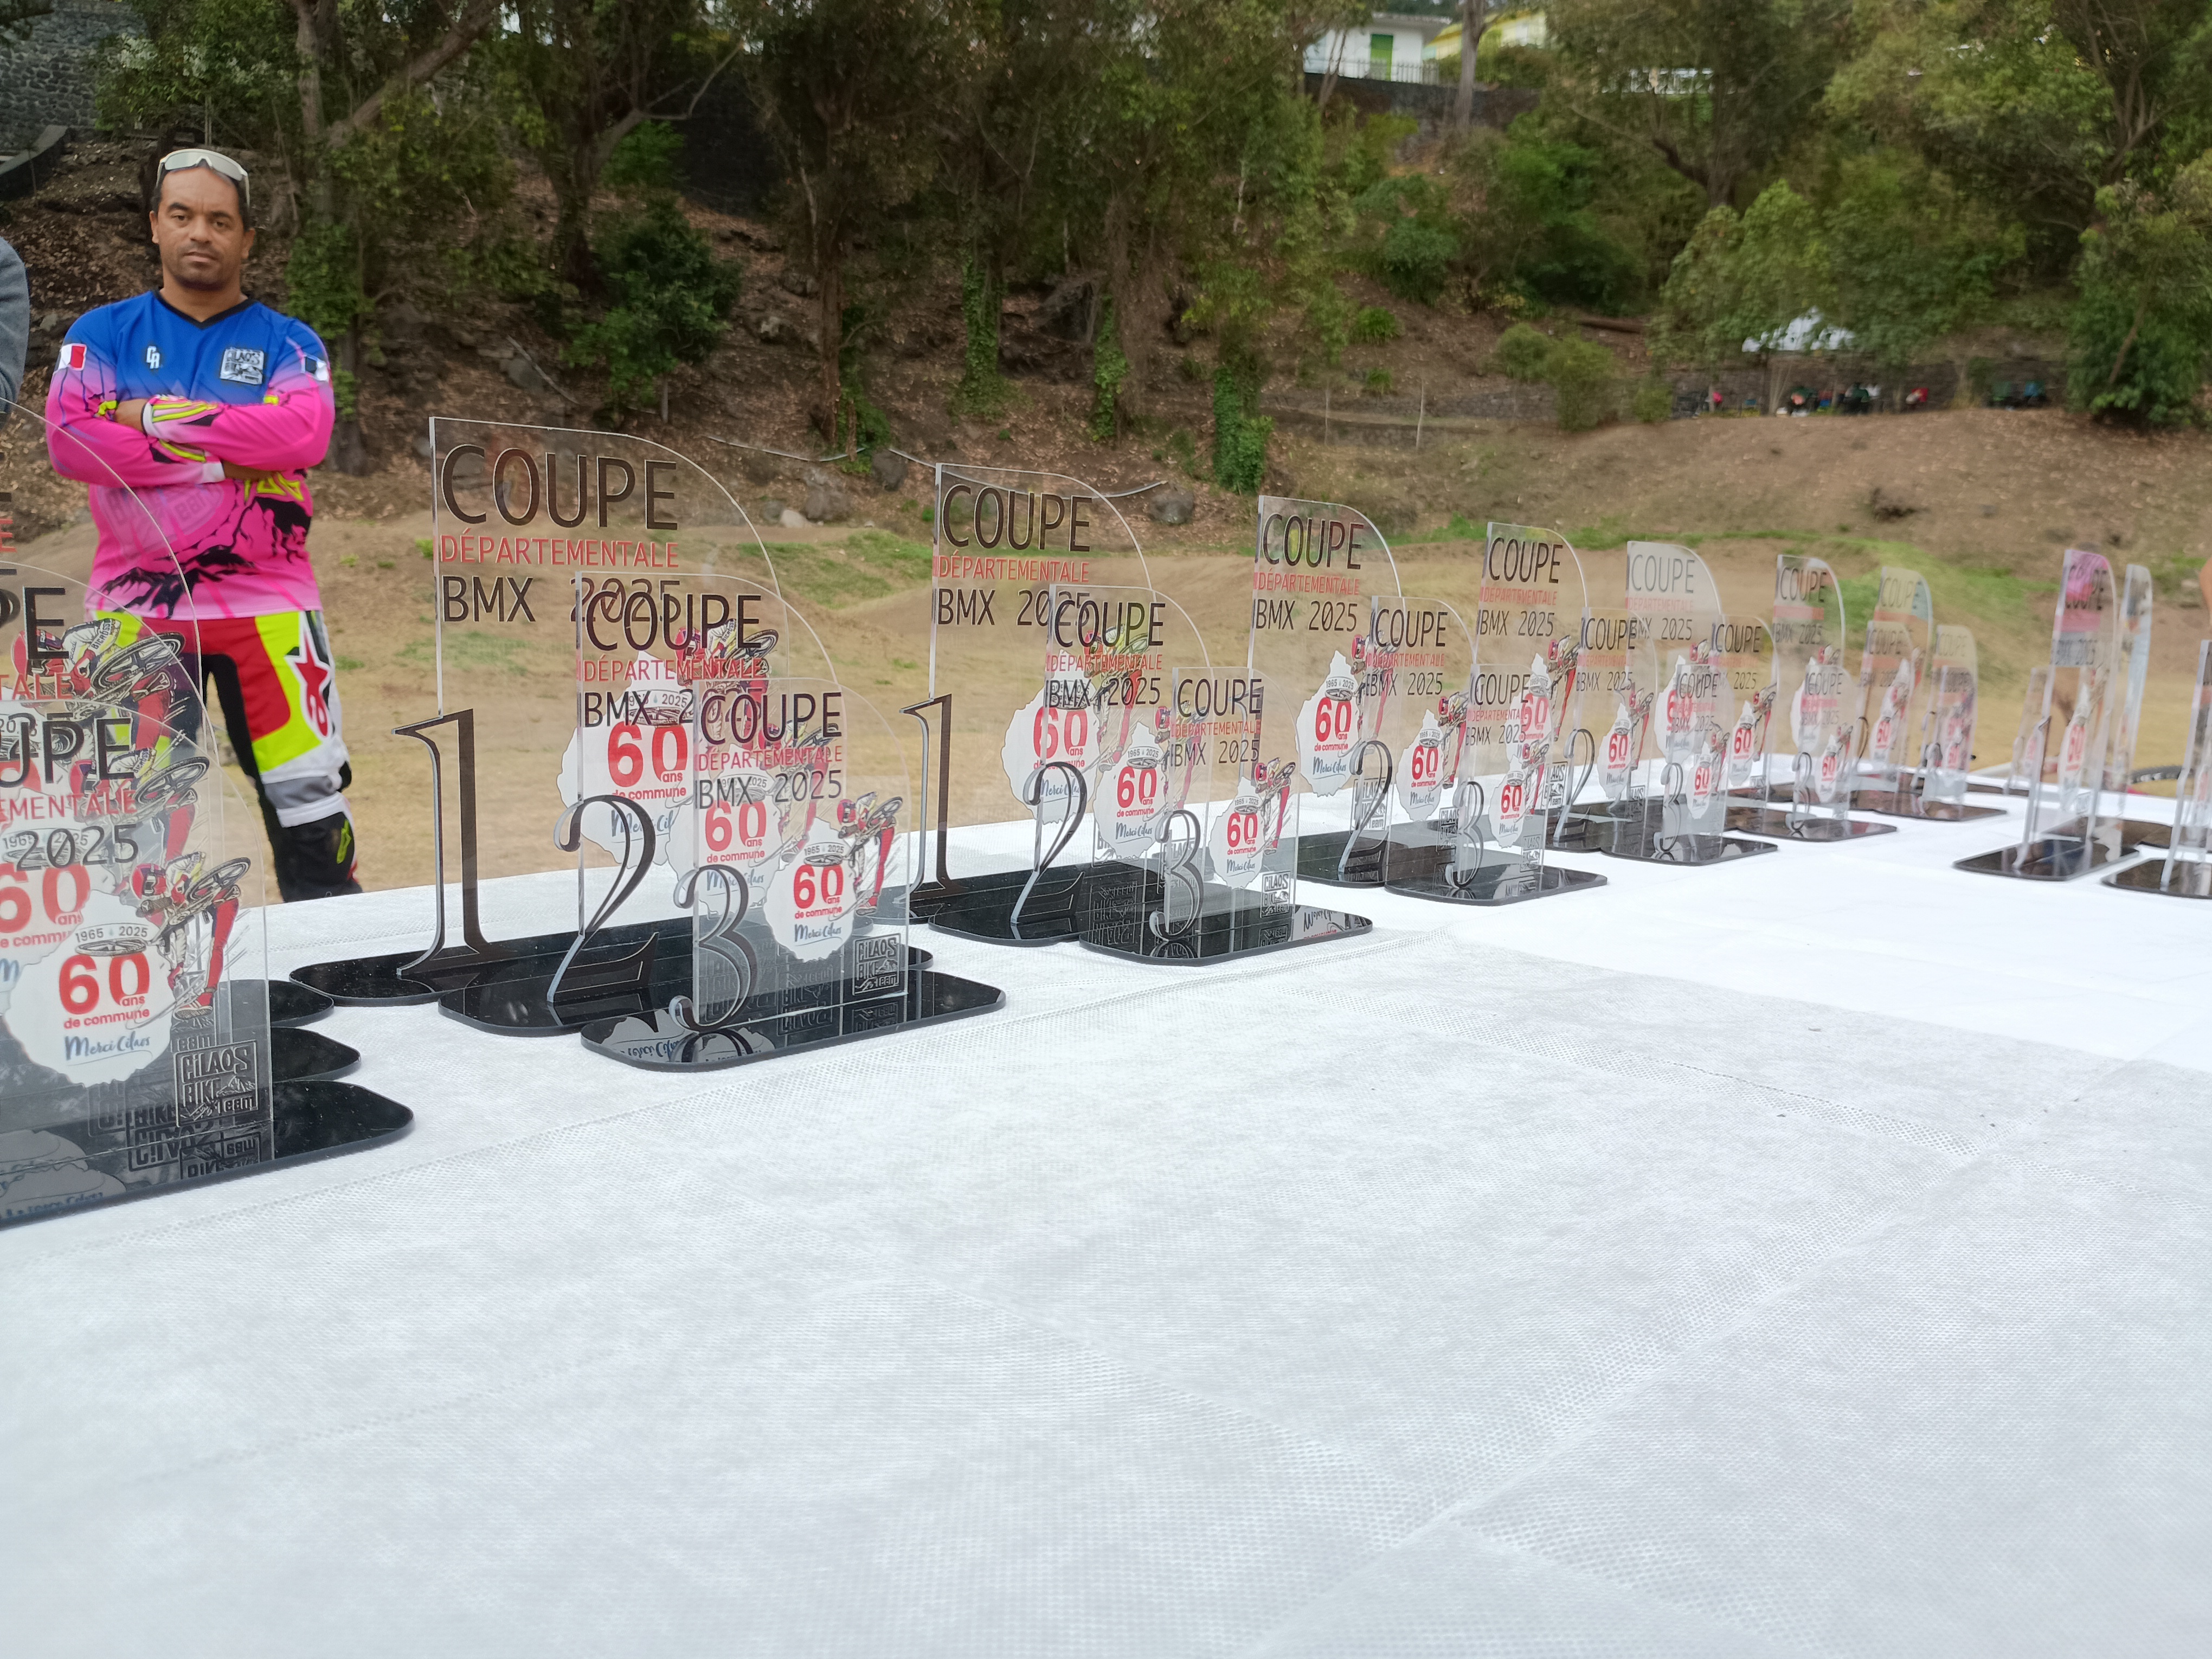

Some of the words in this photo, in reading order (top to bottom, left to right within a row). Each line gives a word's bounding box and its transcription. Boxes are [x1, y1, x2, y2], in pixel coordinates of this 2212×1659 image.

[441, 444, 678, 531] COUPE
[942, 484, 1092, 552] COUPE
[440, 528, 679, 568] DÉPARTEMENTALE
[1263, 513, 1364, 570] COUPE
[938, 549, 1090, 583] DÉPARTEMENTALE
[1489, 537, 1562, 584] COUPE
[1631, 554, 1695, 594] COUPE
[442, 575, 536, 622] BMX
[1258, 568, 1360, 595] DÉPARTEMENTALE
[1780, 567, 1827, 603] COUPE
[586, 590, 761, 651] COUPE
[938, 589, 995, 626] BMX
[1054, 600, 1165, 647] COUPE
[1256, 598, 1295, 630] BMX
[1309, 601, 1358, 632] 2025
[1480, 609, 1509, 636] BMX
[1518, 610, 1554, 636] 2025
[1375, 608, 1448, 648] COUPE
[1585, 618, 1637, 650] COUPE
[1661, 618, 1692, 640] 2025
[1715, 623, 1761, 653] COUPE
[583, 654, 763, 682] DÉPARTEMENTALE
[1326, 679, 1338, 687] 1965
[1342, 679, 1354, 690] 2025
[1407, 672, 1443, 696] 2025
[1606, 671, 1632, 691] 2025
[1733, 672, 1757, 690] 2025
[1050, 679, 1091, 708] BMX
[1107, 677, 1161, 706] 2025
[1178, 678, 1262, 717] COUPE
[1474, 674, 1531, 705] COUPE
[584, 690, 651, 728] BMX
[701, 692, 841, 745] COUPE
[1315, 697, 1352, 742] 60
[1033, 706, 1088, 759] 60
[1322, 742, 1348, 751] commune
[1499, 724, 1527, 744] 2025
[1609, 733, 1628, 763] 60
[1734, 728, 1752, 754] 60
[608, 720, 689, 788] 60
[698, 745, 843, 771] DÉPARTEMENTALE
[1069, 748, 1083, 756] ans
[1175, 742, 1206, 767] BMX
[1218, 739, 1259, 764] 2025
[1412, 745, 1438, 780] 60
[628, 787, 687, 801] commune
[663, 771, 683, 783] ans
[699, 776, 753, 810] BMX
[775, 770, 841, 803] 2025
[1117, 766, 1157, 808] 60
[1126, 807, 1154, 816] commune
[1501, 784, 1522, 813] 60
[705, 799, 767, 852] 60
[747, 838, 763, 847] ans
[1011, 761, 1088, 923] 2
[1227, 812, 1258, 847] 60
[16, 824, 139, 872] 2025
[707, 854, 718, 863] de
[720, 849, 765, 863] commune
[827, 844, 844, 854] 2025
[793, 864, 844, 909] 60
[1149, 809, 1204, 941] 3
[547, 794, 660, 1003] 2
[794, 911, 804, 919] de
[805, 905, 843, 918] commune
[827, 896, 840, 904] ans
[75, 928, 104, 943] 1965
[119, 926, 148, 938] 2025
[669, 864, 758, 1031] 3
[59, 952, 150, 1015] 60
[122, 995, 146, 1007] ans
[64, 1017, 81, 1029] de
[83, 1008, 150, 1026] commune
